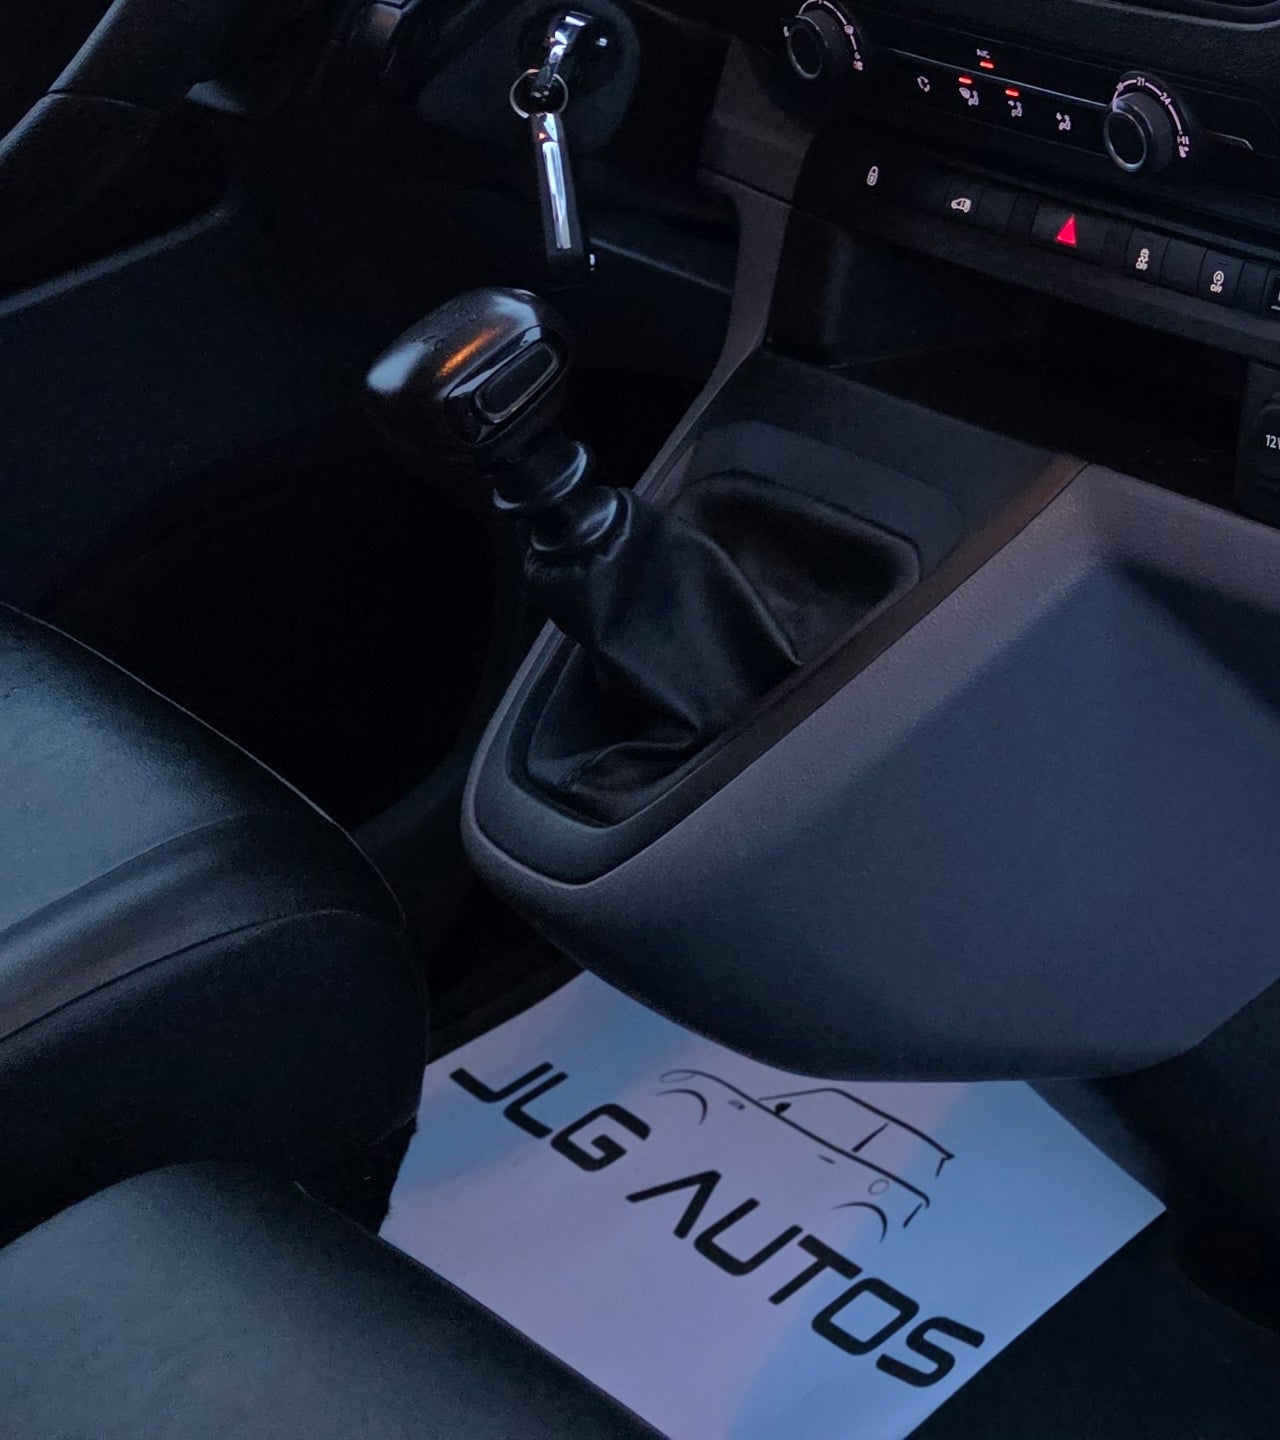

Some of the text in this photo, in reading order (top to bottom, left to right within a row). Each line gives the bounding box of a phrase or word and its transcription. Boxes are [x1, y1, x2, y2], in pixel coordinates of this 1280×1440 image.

[1137, 76, 1145, 87] 21
[1160, 92, 1172, 105] 24
[449, 1059, 985, 1388] JLG AUTOS
